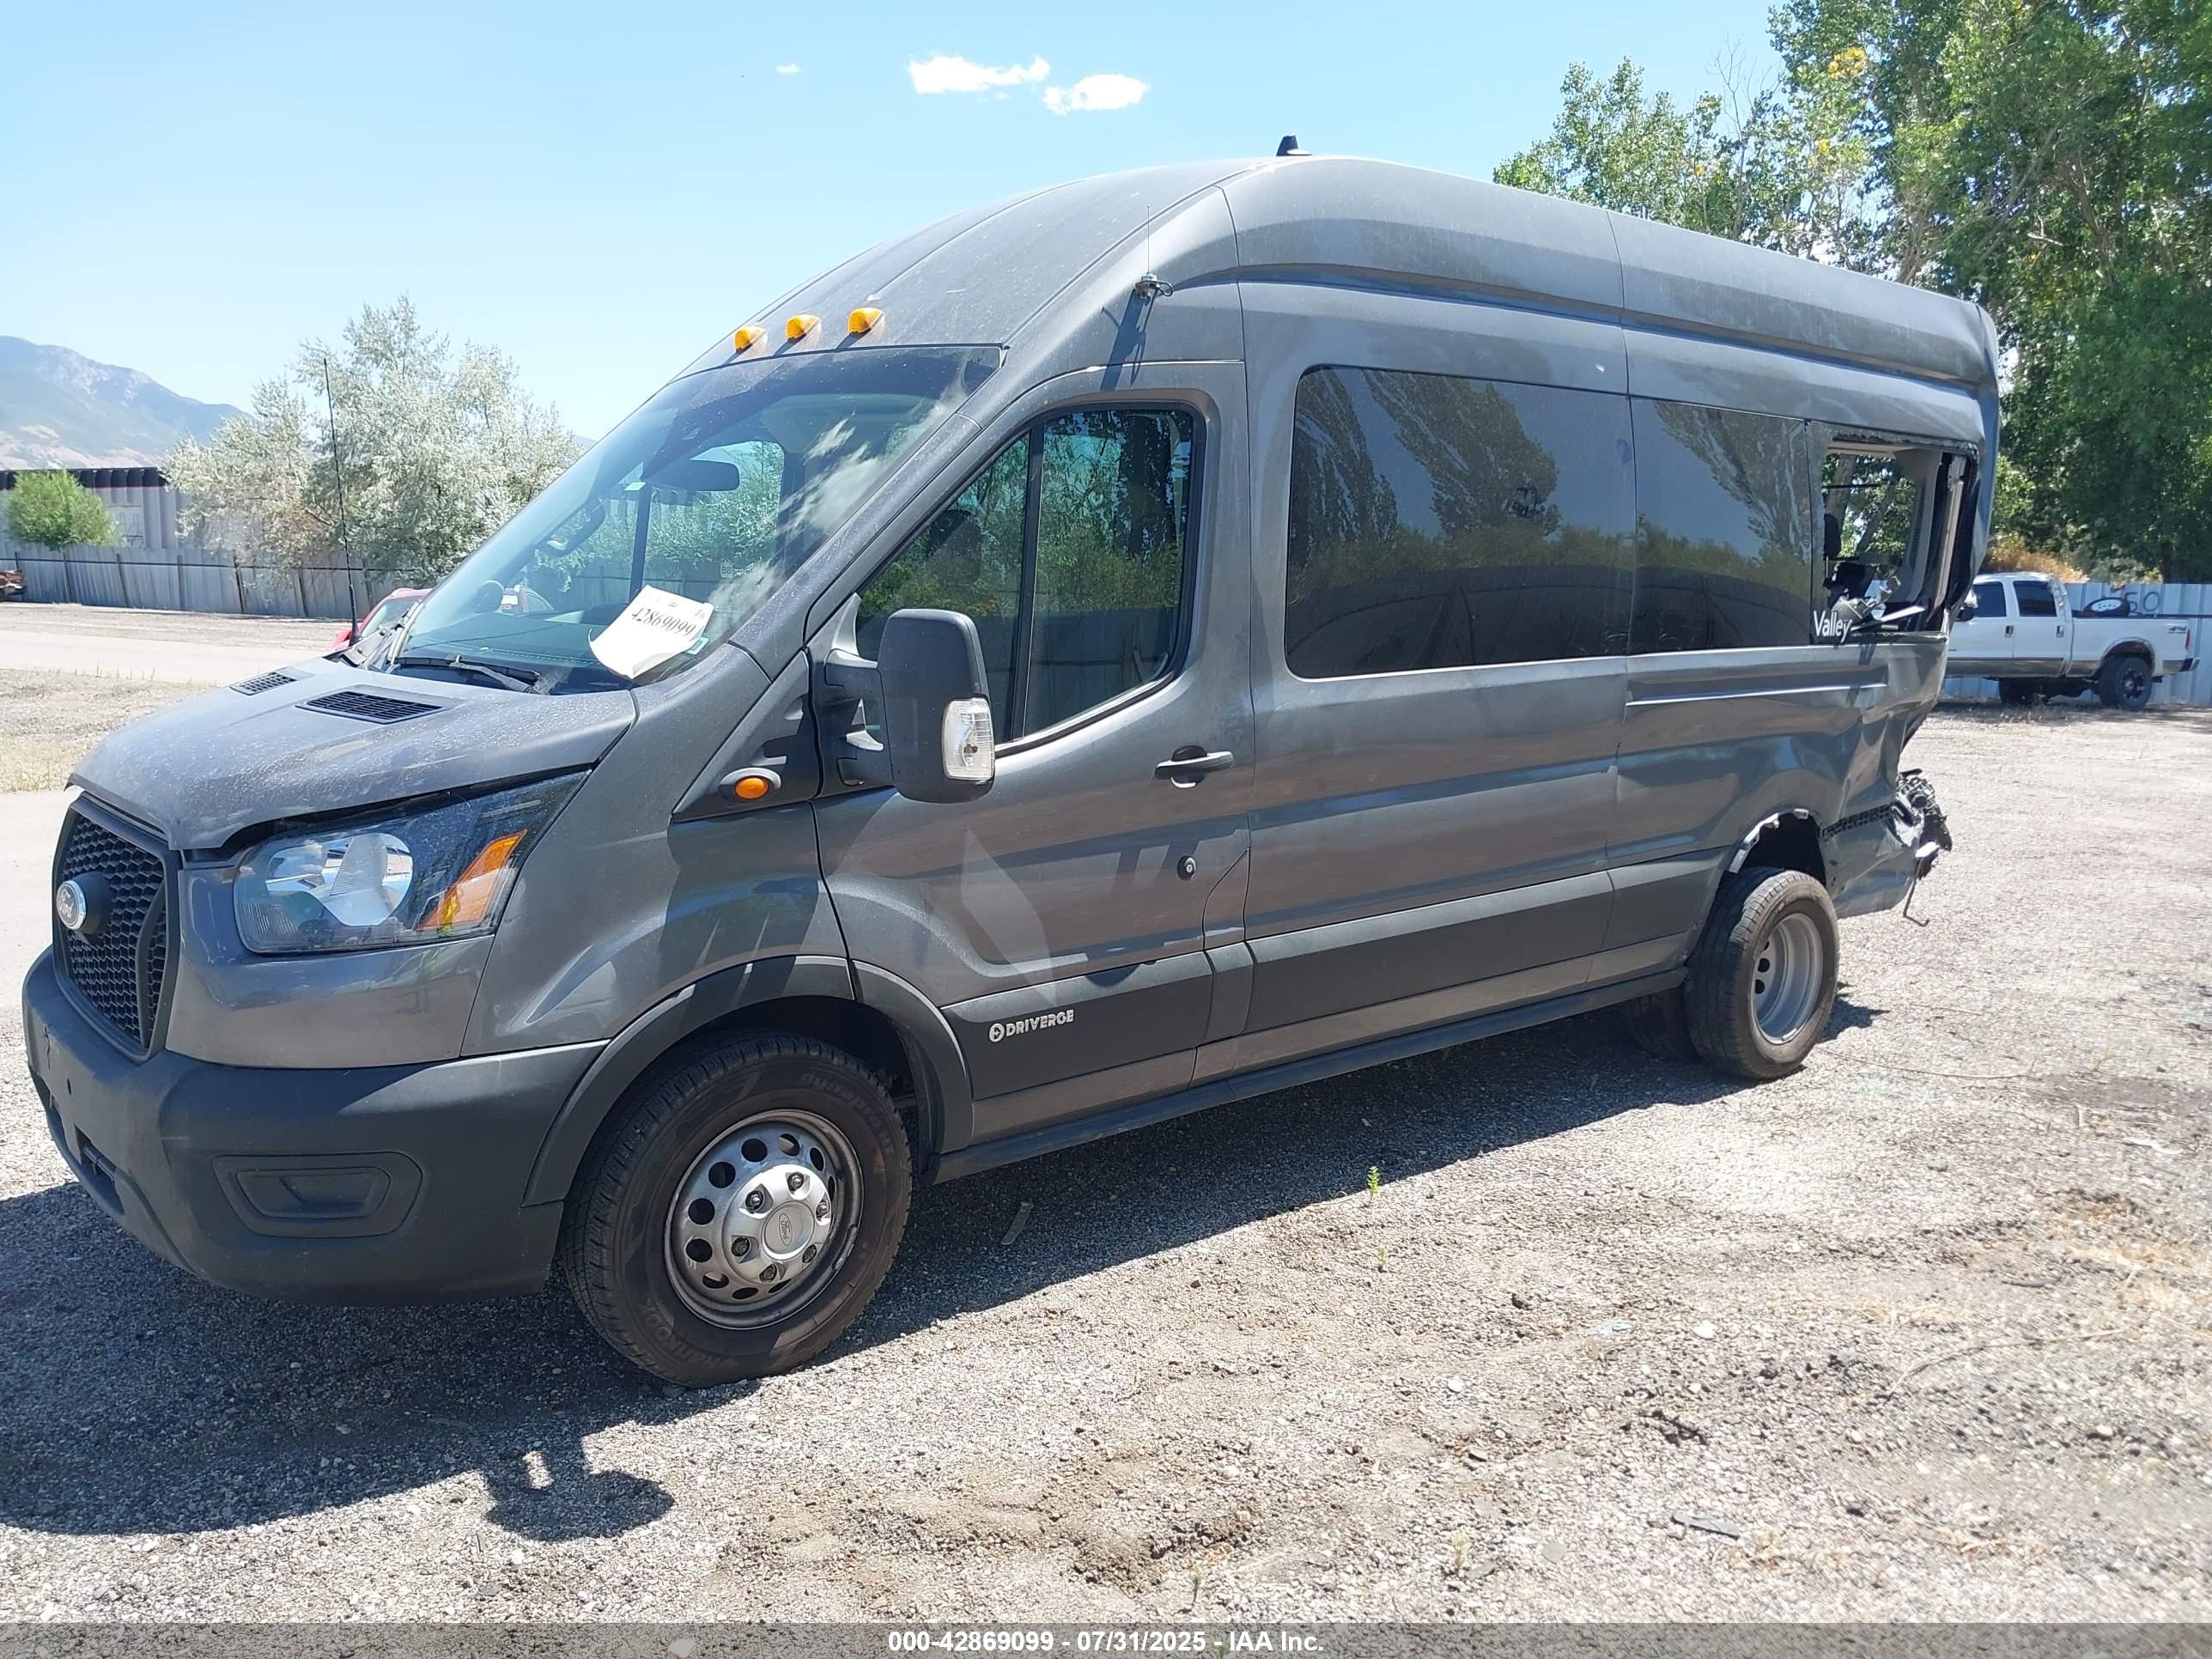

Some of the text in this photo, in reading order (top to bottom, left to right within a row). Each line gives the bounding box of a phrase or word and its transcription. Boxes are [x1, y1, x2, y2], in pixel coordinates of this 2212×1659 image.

[631, 607, 696, 637] 42869099
[1813, 610, 1853, 643] Valley
[1006, 1009, 1074, 1036] DRIVERGE
